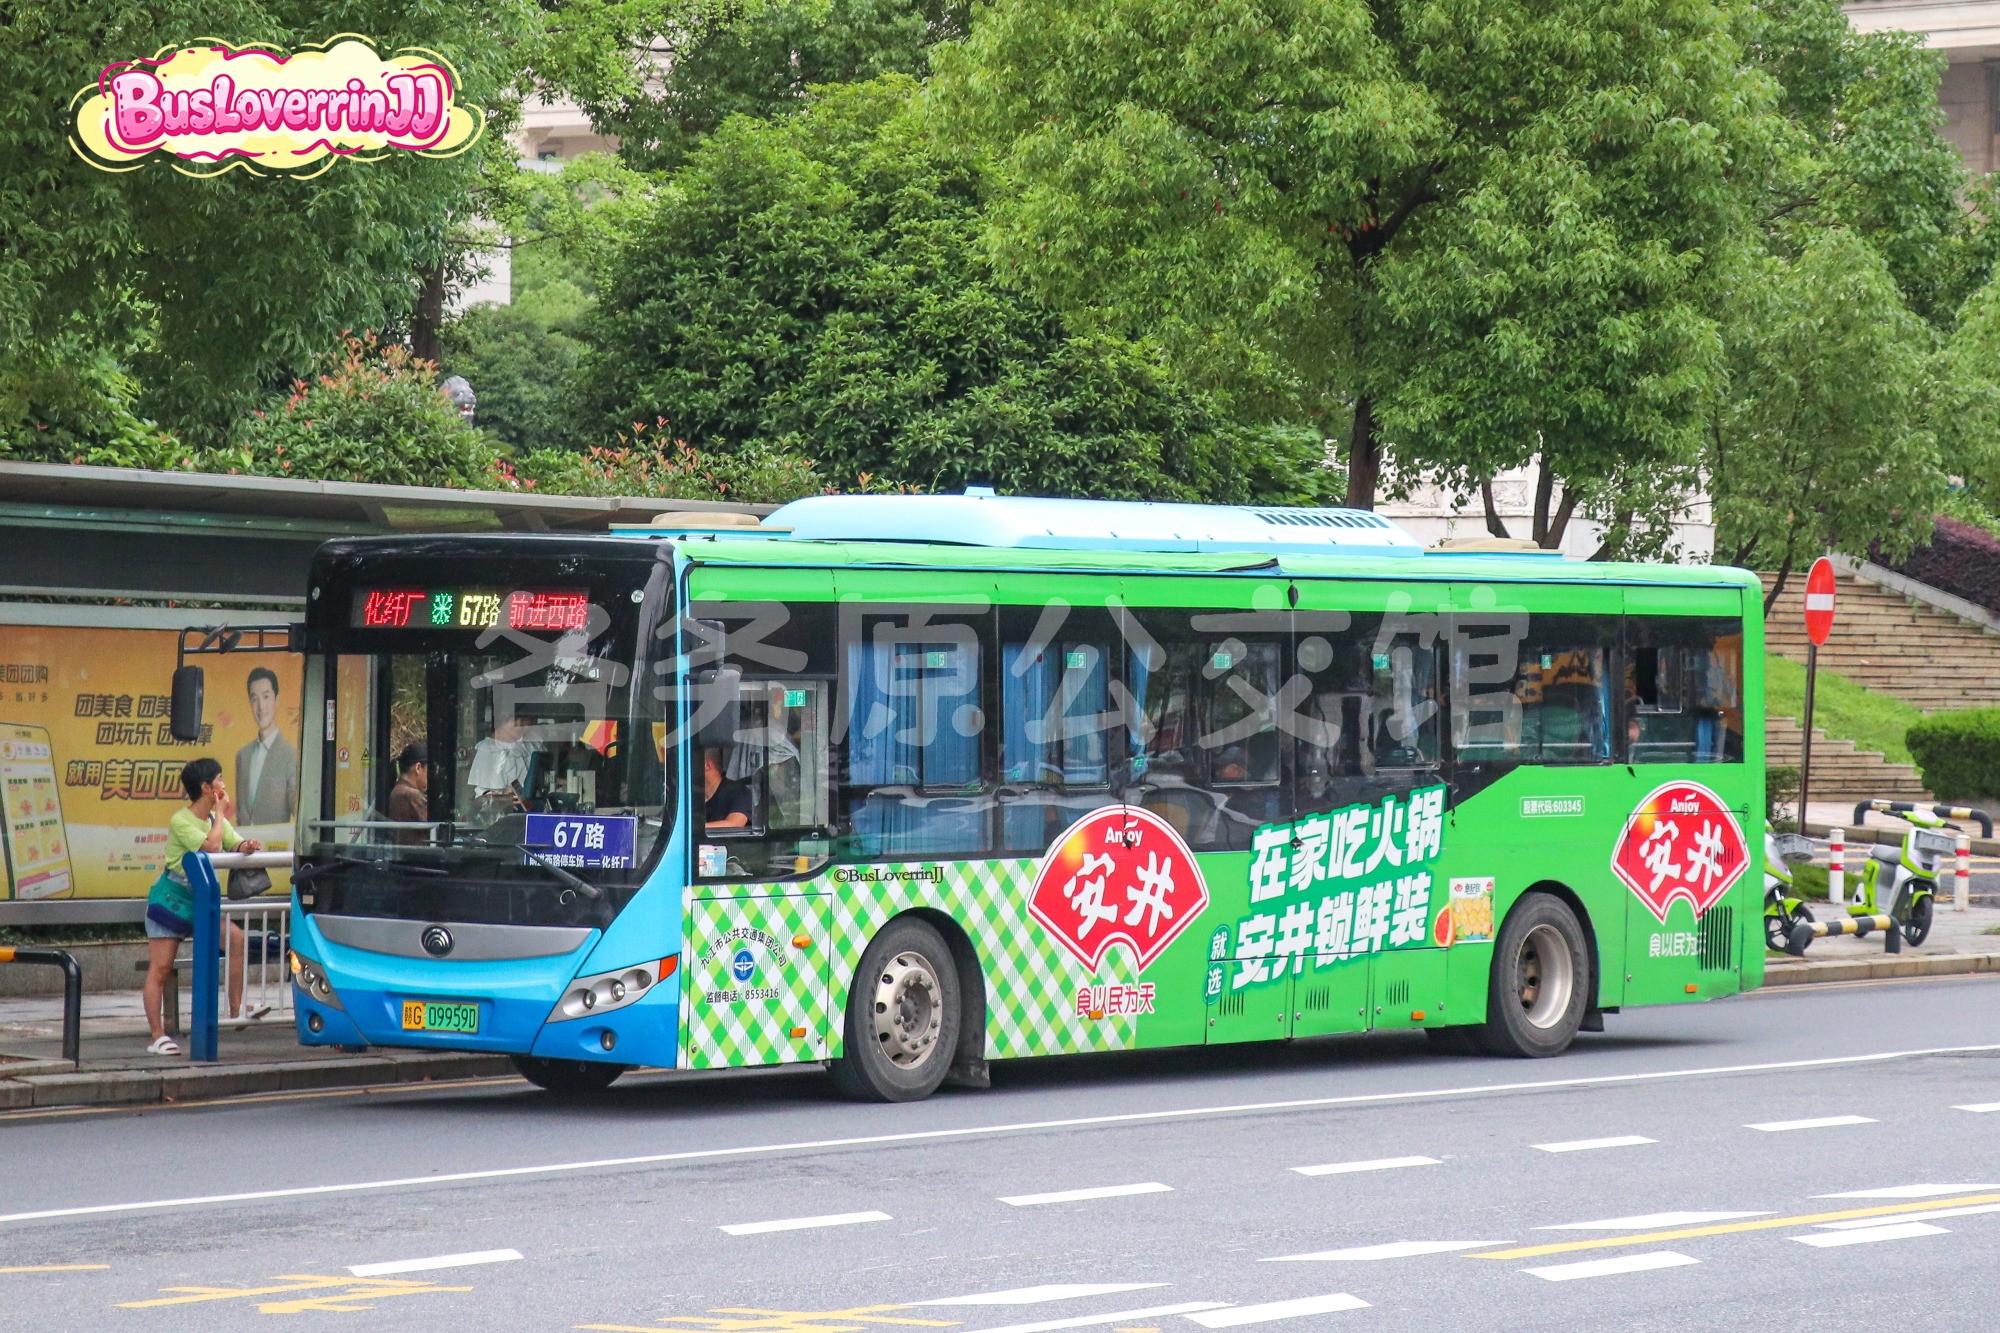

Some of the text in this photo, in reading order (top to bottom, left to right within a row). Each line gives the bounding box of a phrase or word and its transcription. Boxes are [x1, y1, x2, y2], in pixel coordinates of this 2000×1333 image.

[365, 591, 587, 629] 化纤厂 67路 前进西路
[75, 693, 173, 718] 团美食 团美
[95, 722, 214, 747] 团玩乐 团摩
[65, 758, 189, 800] 就用美团团
[1670, 792, 1700, 816] Anjoy
[553, 821, 605, 850] 67路
[1248, 787, 1446, 904] 在家吃火锅
[1639, 818, 1725, 894] 安井
[1062, 849, 1175, 940] 安井
[700, 927, 787, 970] 九江市公共交通集团公司
[1232, 871, 1432, 990] 安井锁鲜装
[1205, 930, 1228, 997] 就选
[1076, 984, 1155, 1016] 食以民为天
